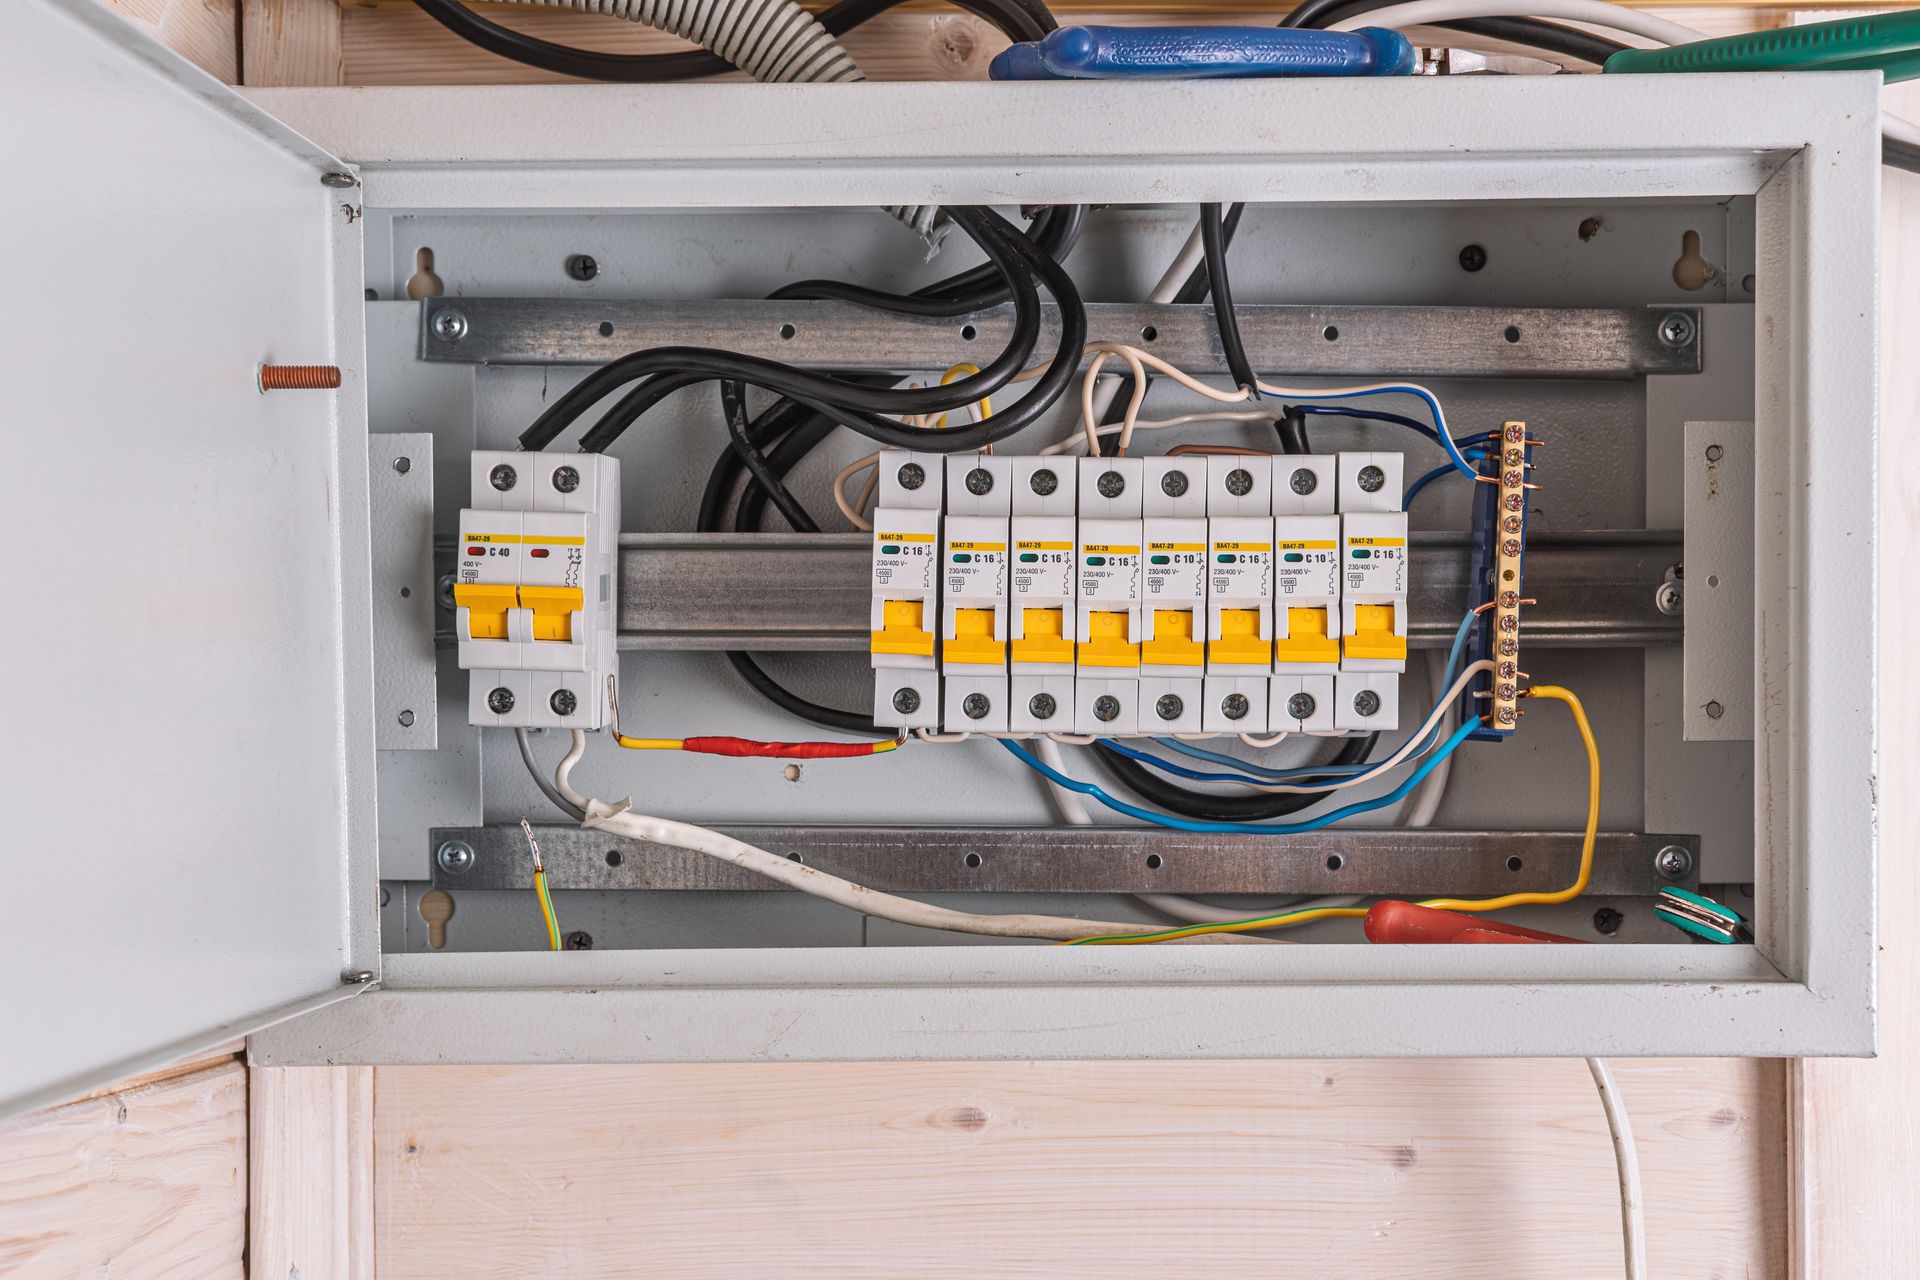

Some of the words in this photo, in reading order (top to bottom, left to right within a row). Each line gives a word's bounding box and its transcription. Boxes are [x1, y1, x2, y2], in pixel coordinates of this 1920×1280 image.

[490, 548, 496, 556] C
[499, 548, 509, 557] 40
[903, 546, 909, 555] C
[912, 547, 922, 555] 16
[1374, 550, 1380, 558] C
[975, 554, 980, 562] C
[984, 554, 994, 562] 16
[1042, 554, 1047, 562] C
[1051, 554, 1061, 562] 16
[1109, 557, 1114, 566] C
[1118, 558, 1128, 566] 16
[1175, 555, 1180, 563] C
[1184, 555, 1194, 563] 10
[1240, 555, 1245, 563] C
[1249, 555, 1259, 563] 16
[1306, 554, 1312, 562] C
[1315, 554, 1326, 562] 10
